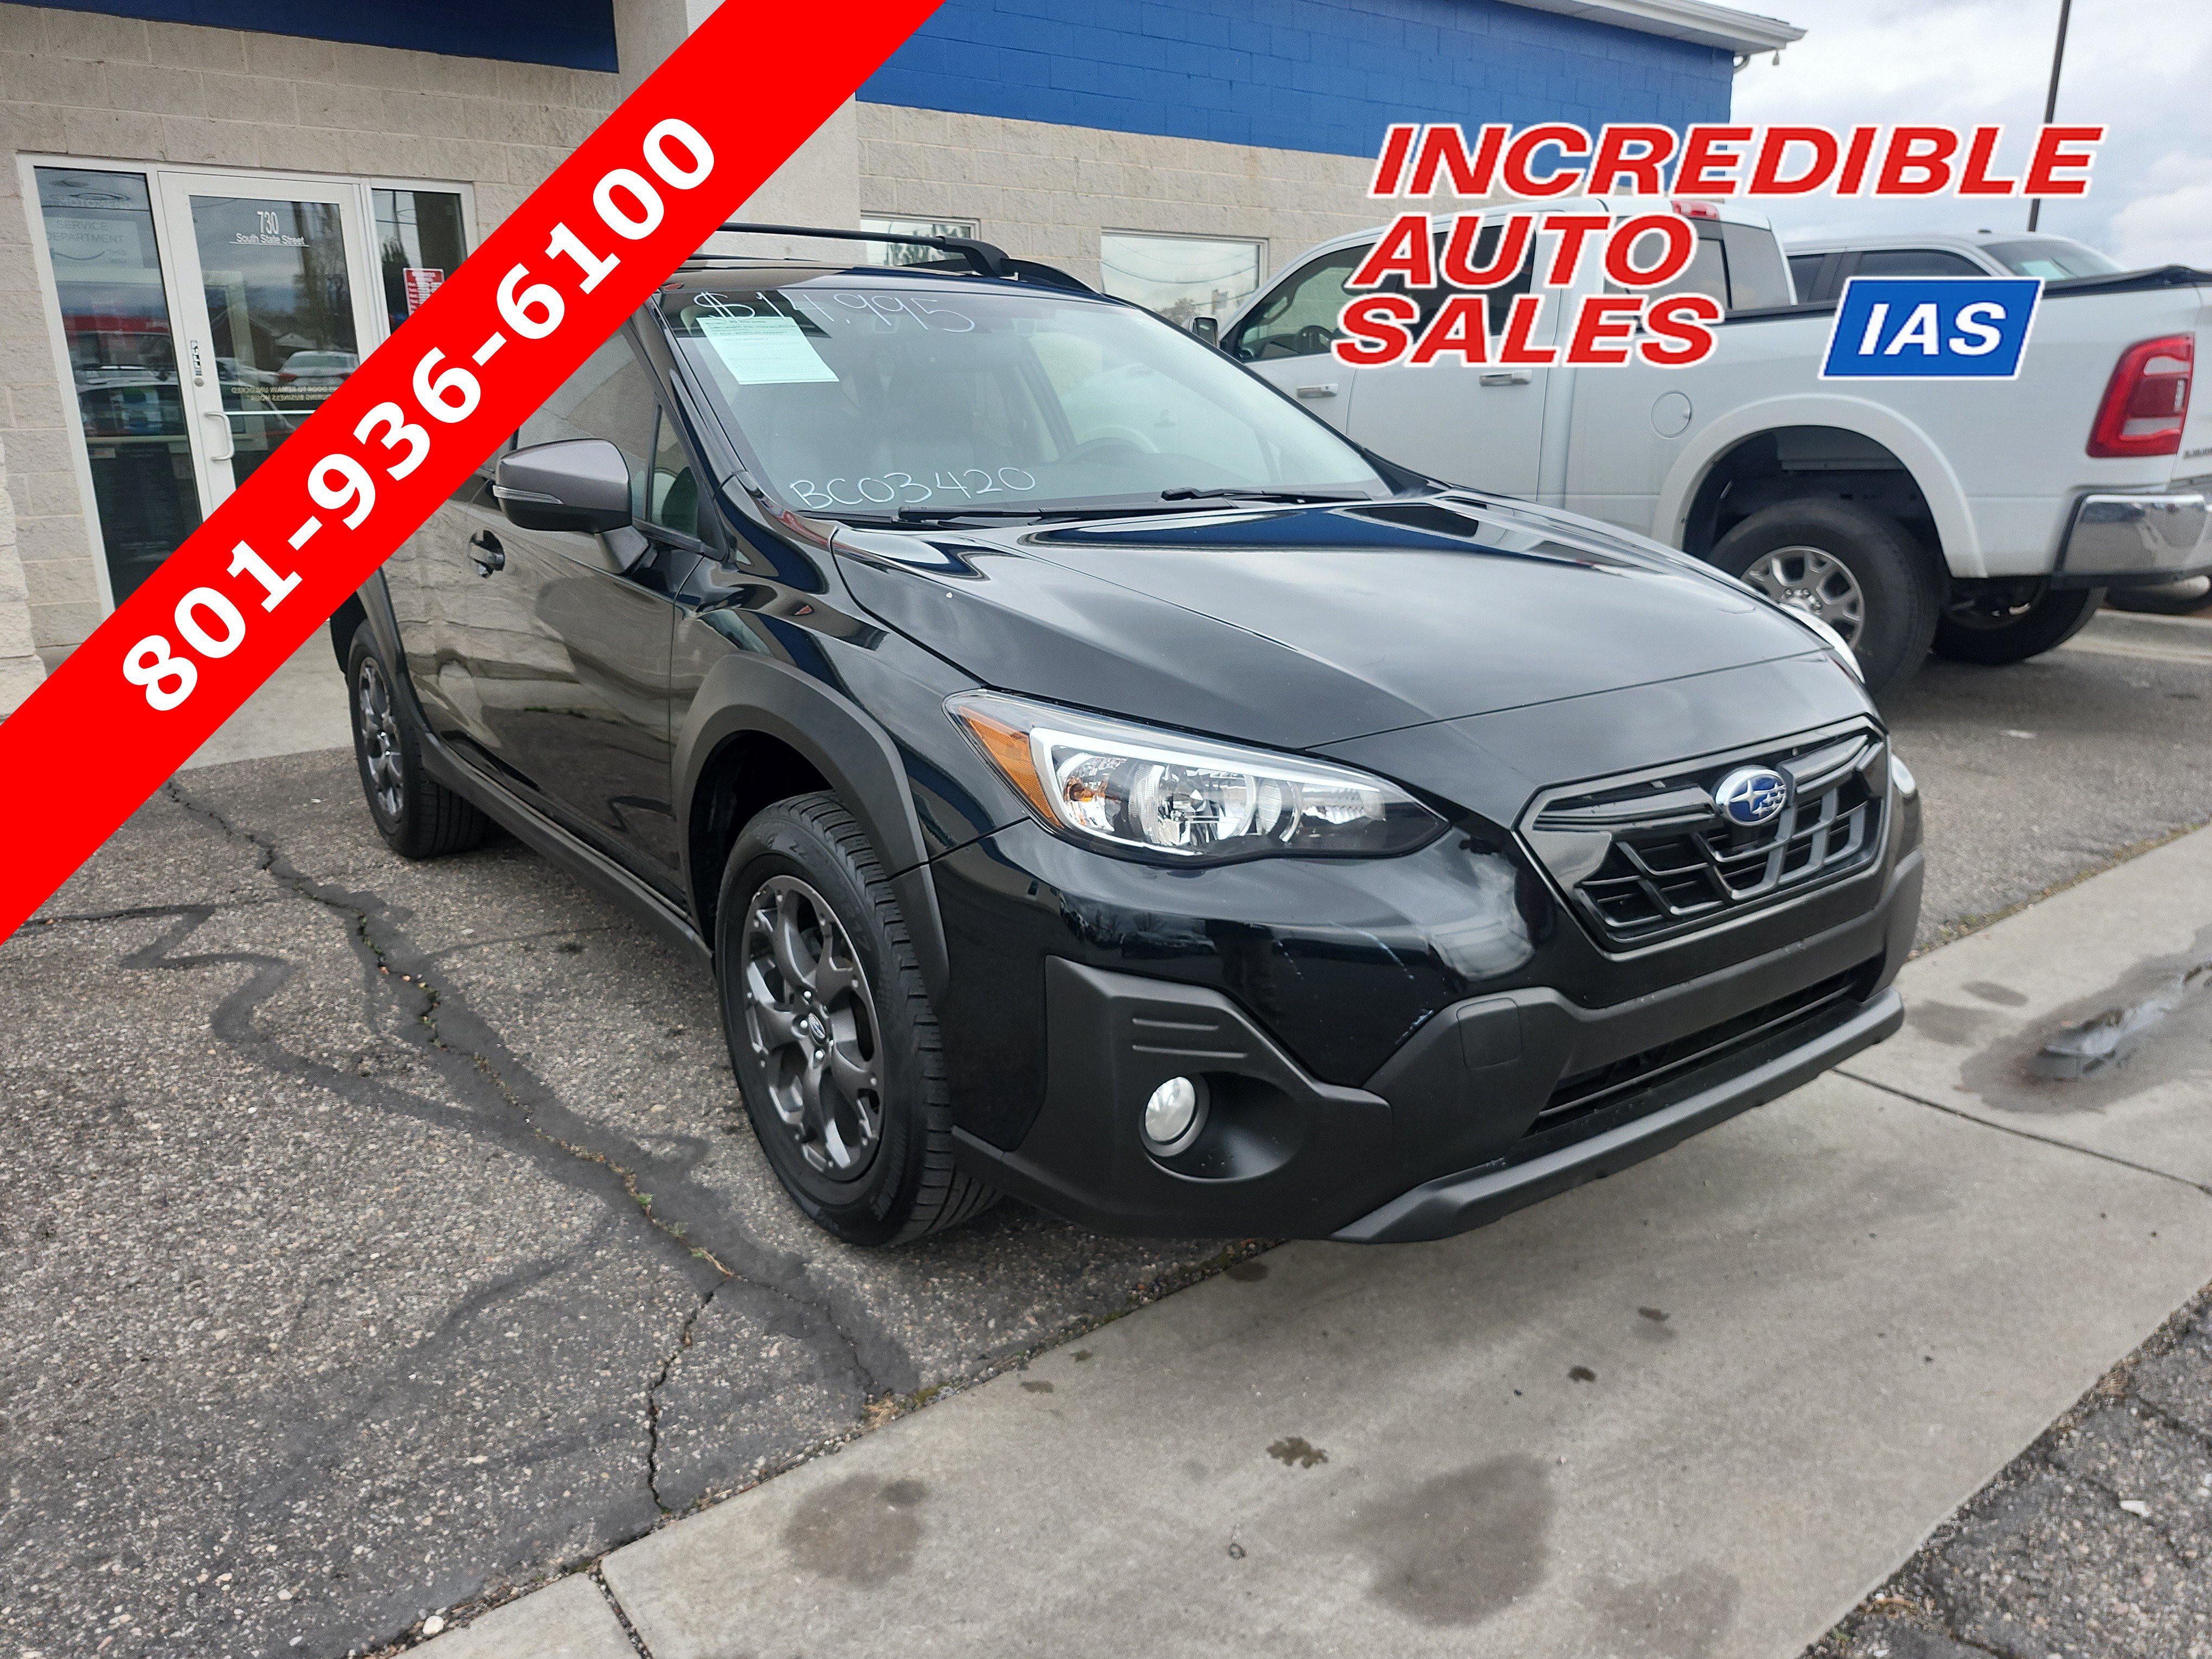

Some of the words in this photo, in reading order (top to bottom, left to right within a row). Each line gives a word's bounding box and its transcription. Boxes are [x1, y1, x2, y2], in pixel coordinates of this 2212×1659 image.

[56, 220, 108, 231] SERVICE
[256, 211, 279, 234] 730
[236, 233, 259, 243] South
[260, 234, 281, 244] State
[281, 235, 305, 245] Street
